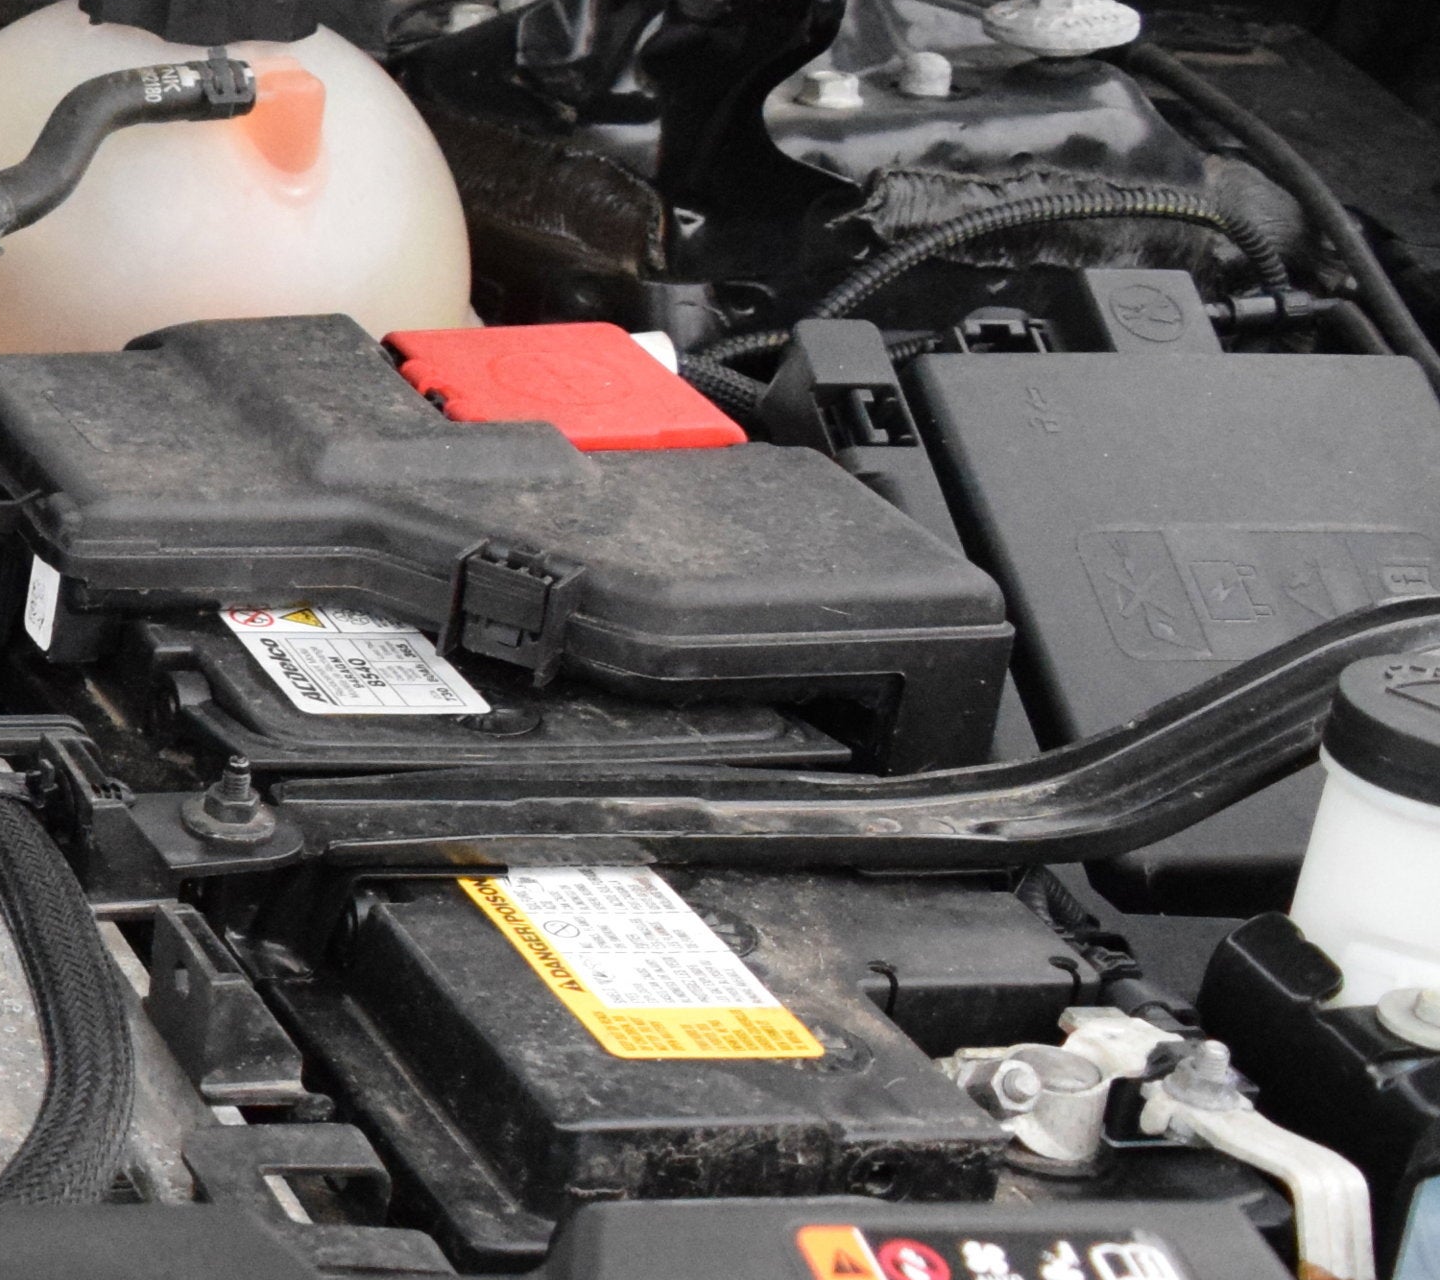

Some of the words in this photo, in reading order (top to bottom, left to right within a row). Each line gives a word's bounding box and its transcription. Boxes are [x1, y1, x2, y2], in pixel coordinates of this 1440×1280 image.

[259, 637, 327, 703] ACDelco
[347, 657, 386, 688] 8540
[437, 687, 458, 702] 730
